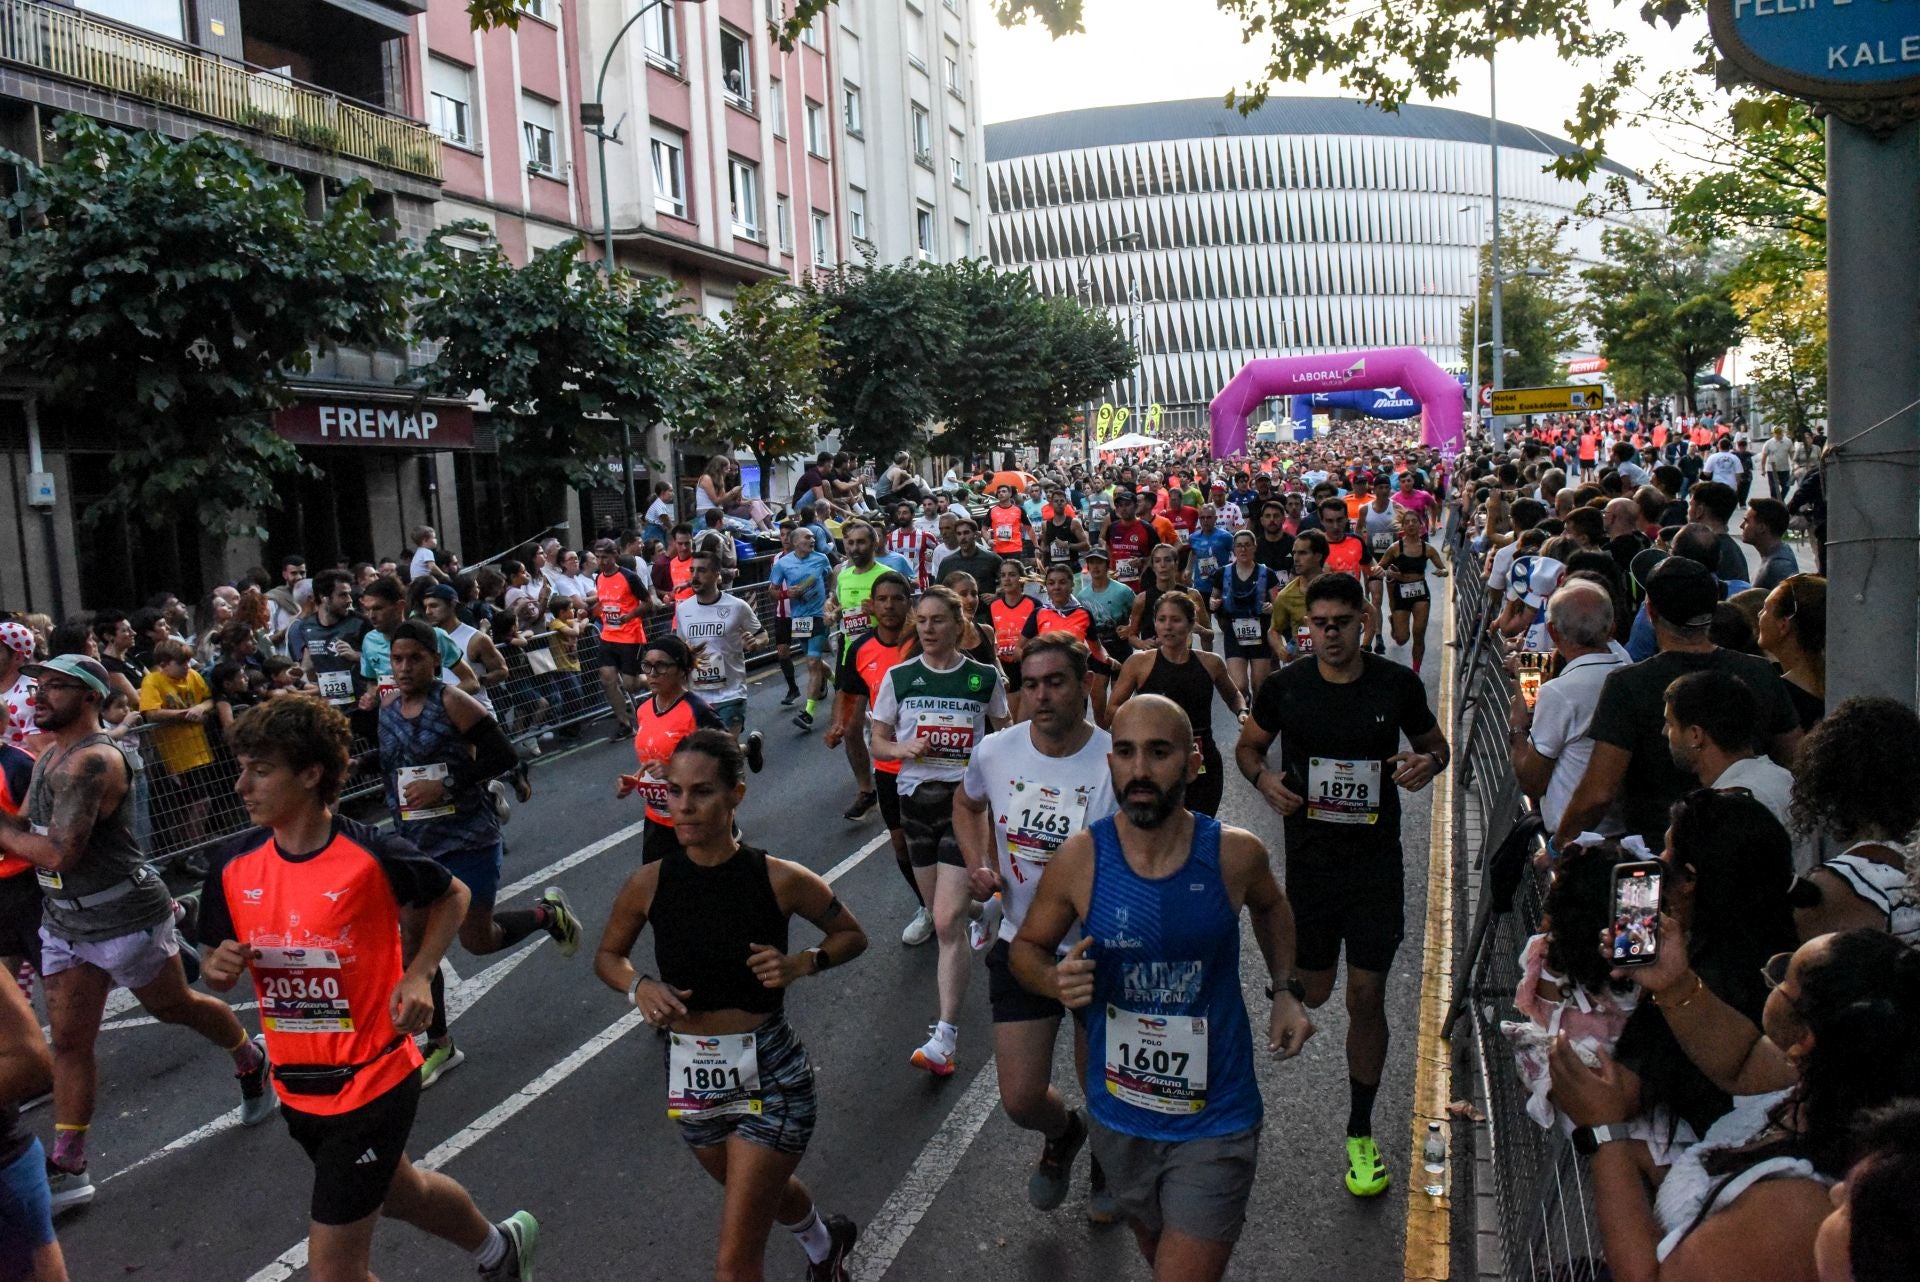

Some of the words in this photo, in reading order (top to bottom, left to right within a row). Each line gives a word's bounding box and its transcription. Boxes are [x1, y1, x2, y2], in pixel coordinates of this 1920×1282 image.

[1292, 370, 1342, 383] LABORAL
[1519, 401, 1568, 411] Euskalduna
[318, 406, 438, 440] FREMAP
[689, 623, 723, 637] mume
[795, 620, 811, 629] 1990
[1236, 626, 1257, 635] 1854
[324, 682, 347, 692] 2328
[905, 700, 934, 710] TEAM
[938, 701, 981, 713] IRELAND
[921, 730, 970, 747] 20897
[639, 788, 668, 800] 2123
[1320, 780, 1369, 800] 1878
[1021, 808, 1070, 835] 1463
[262, 976, 340, 1000] 20360
[1124, 989, 1198, 1004] PERPIGNA
[1141, 1038, 1162, 1047] POLO
[1118, 1042, 1190, 1077] 1607
[683, 1066, 741, 1090] 1801
